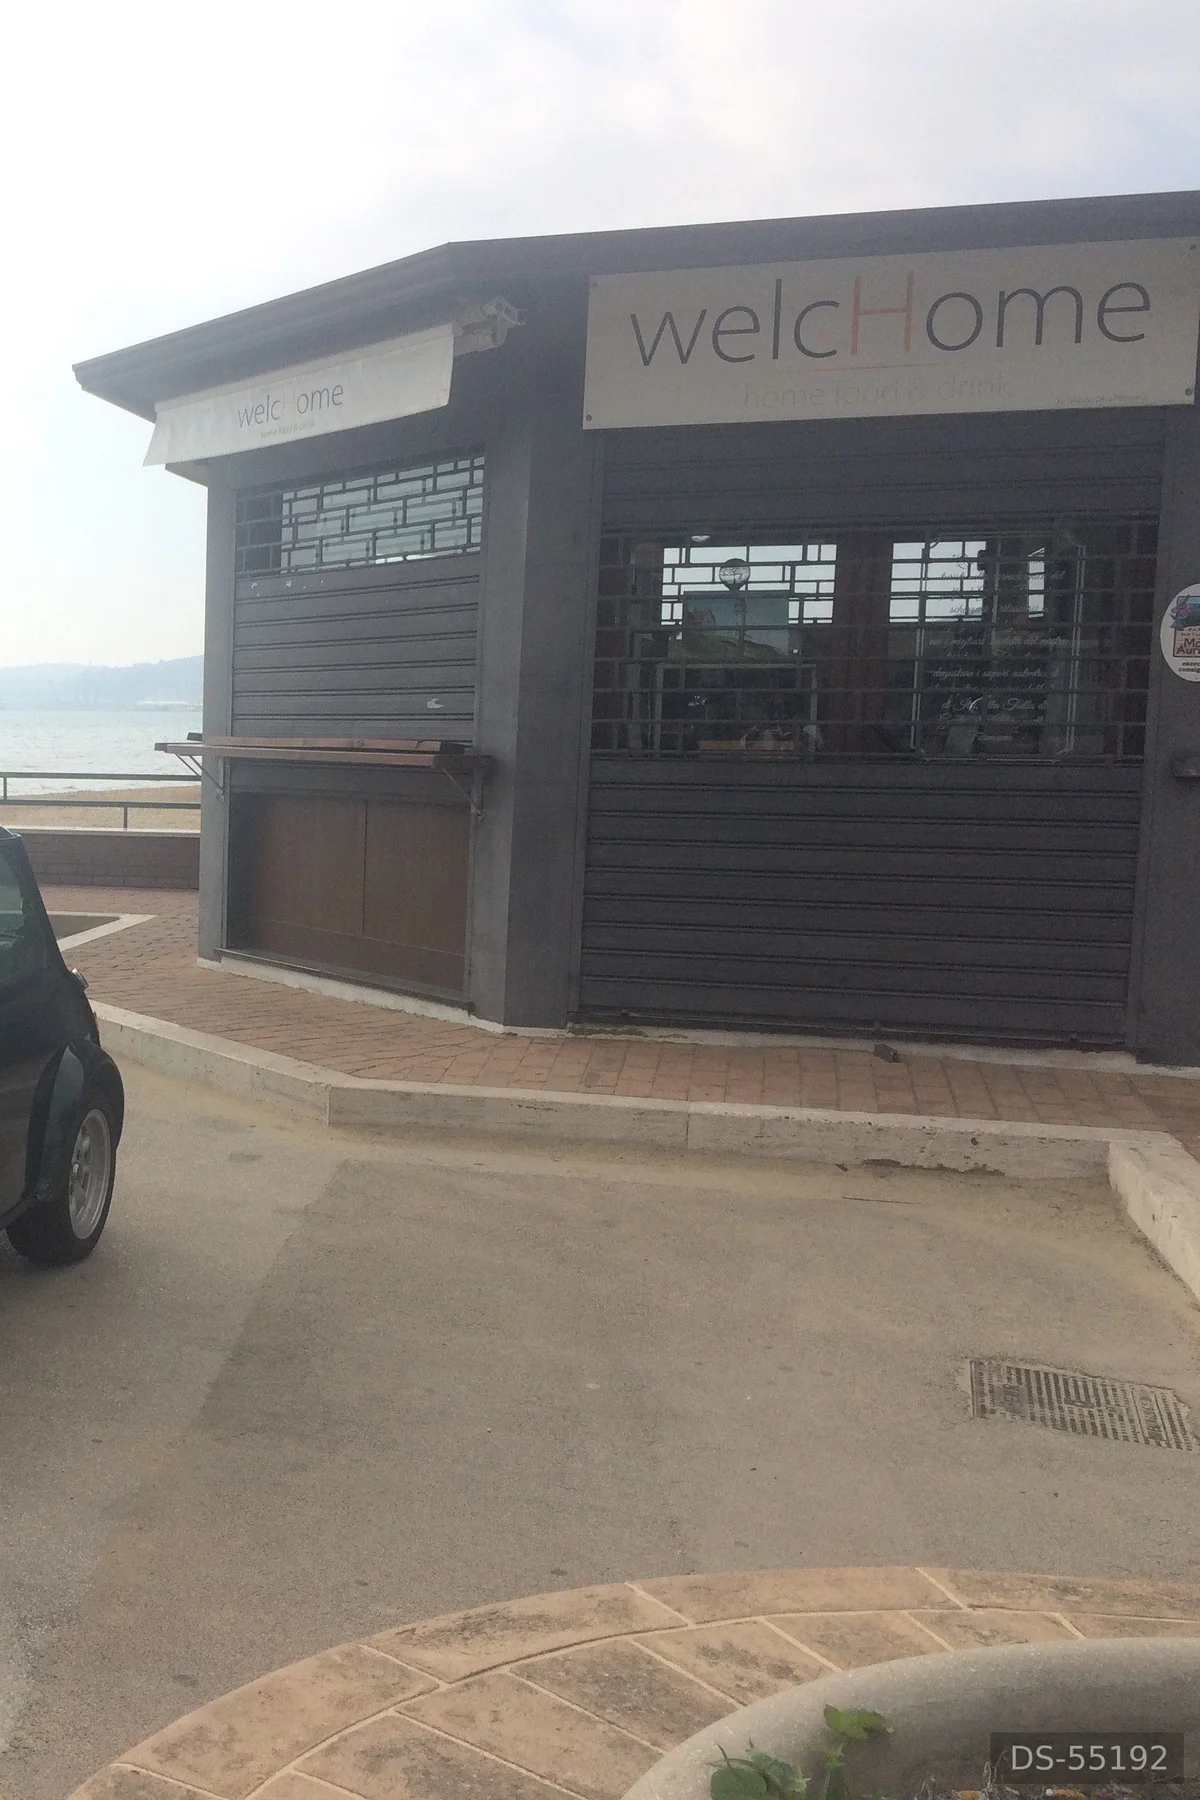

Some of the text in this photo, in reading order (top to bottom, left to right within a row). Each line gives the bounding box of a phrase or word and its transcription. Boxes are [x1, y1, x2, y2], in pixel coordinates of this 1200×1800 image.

[629, 269, 1152, 368] welcHome
[744, 382, 824, 409] home
[835, 378, 899, 405] food
[937, 372, 1013, 401] drink
